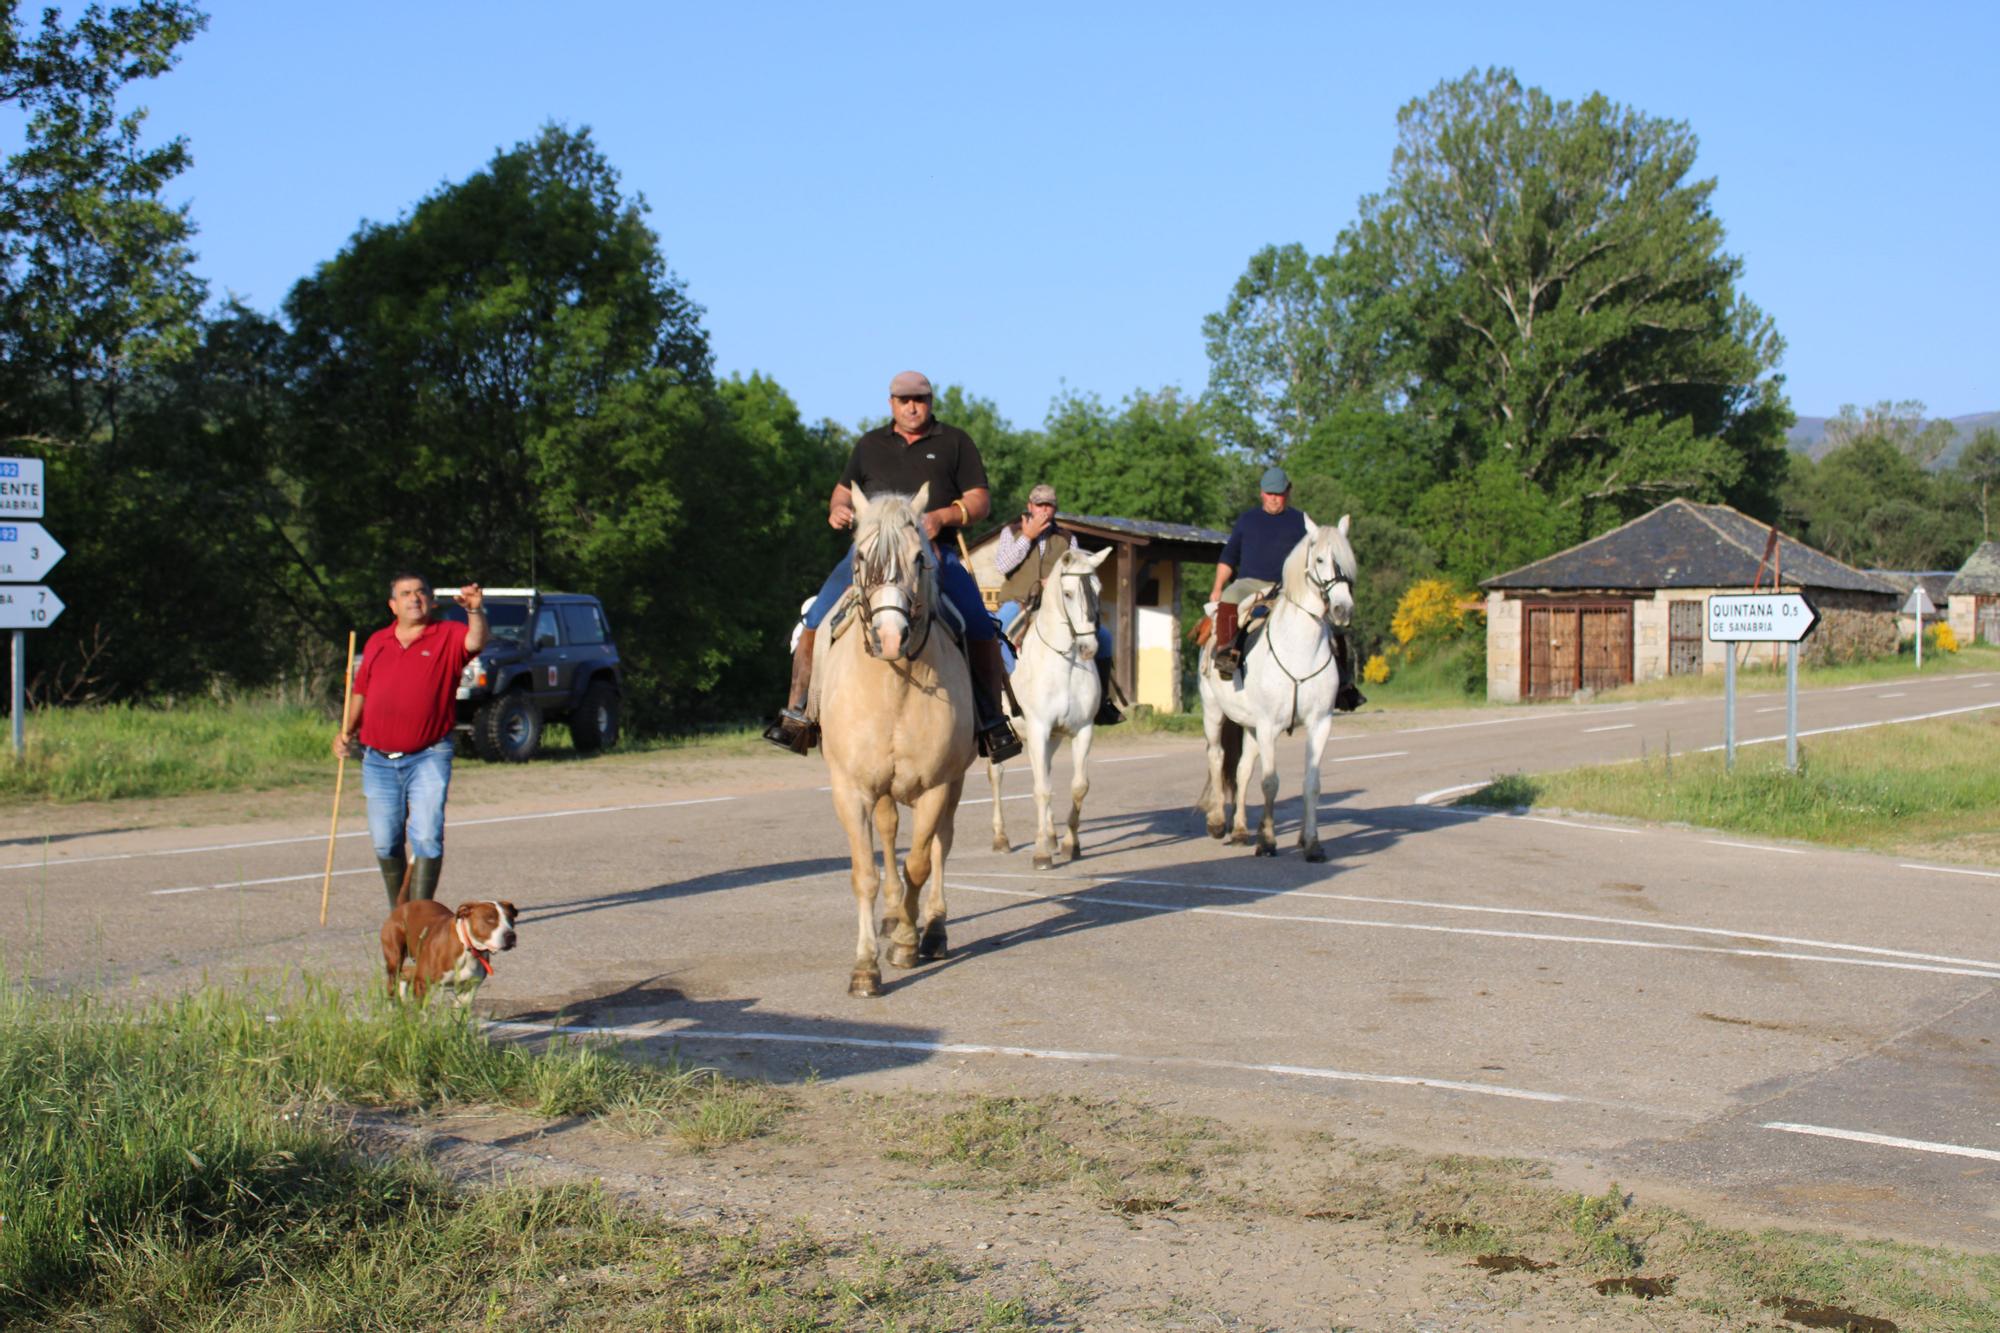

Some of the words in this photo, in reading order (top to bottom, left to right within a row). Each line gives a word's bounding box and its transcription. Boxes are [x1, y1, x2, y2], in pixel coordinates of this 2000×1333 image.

[0, 483, 39, 496] ENTE
[31, 547, 39, 560] 3
[38, 592, 46, 604] 7
[31, 609, 46, 621] 10
[1713, 603, 1773, 617] QUINTANA
[1713, 622, 1724, 632] DE
[1728, 622, 1773, 632] SANABRIA
